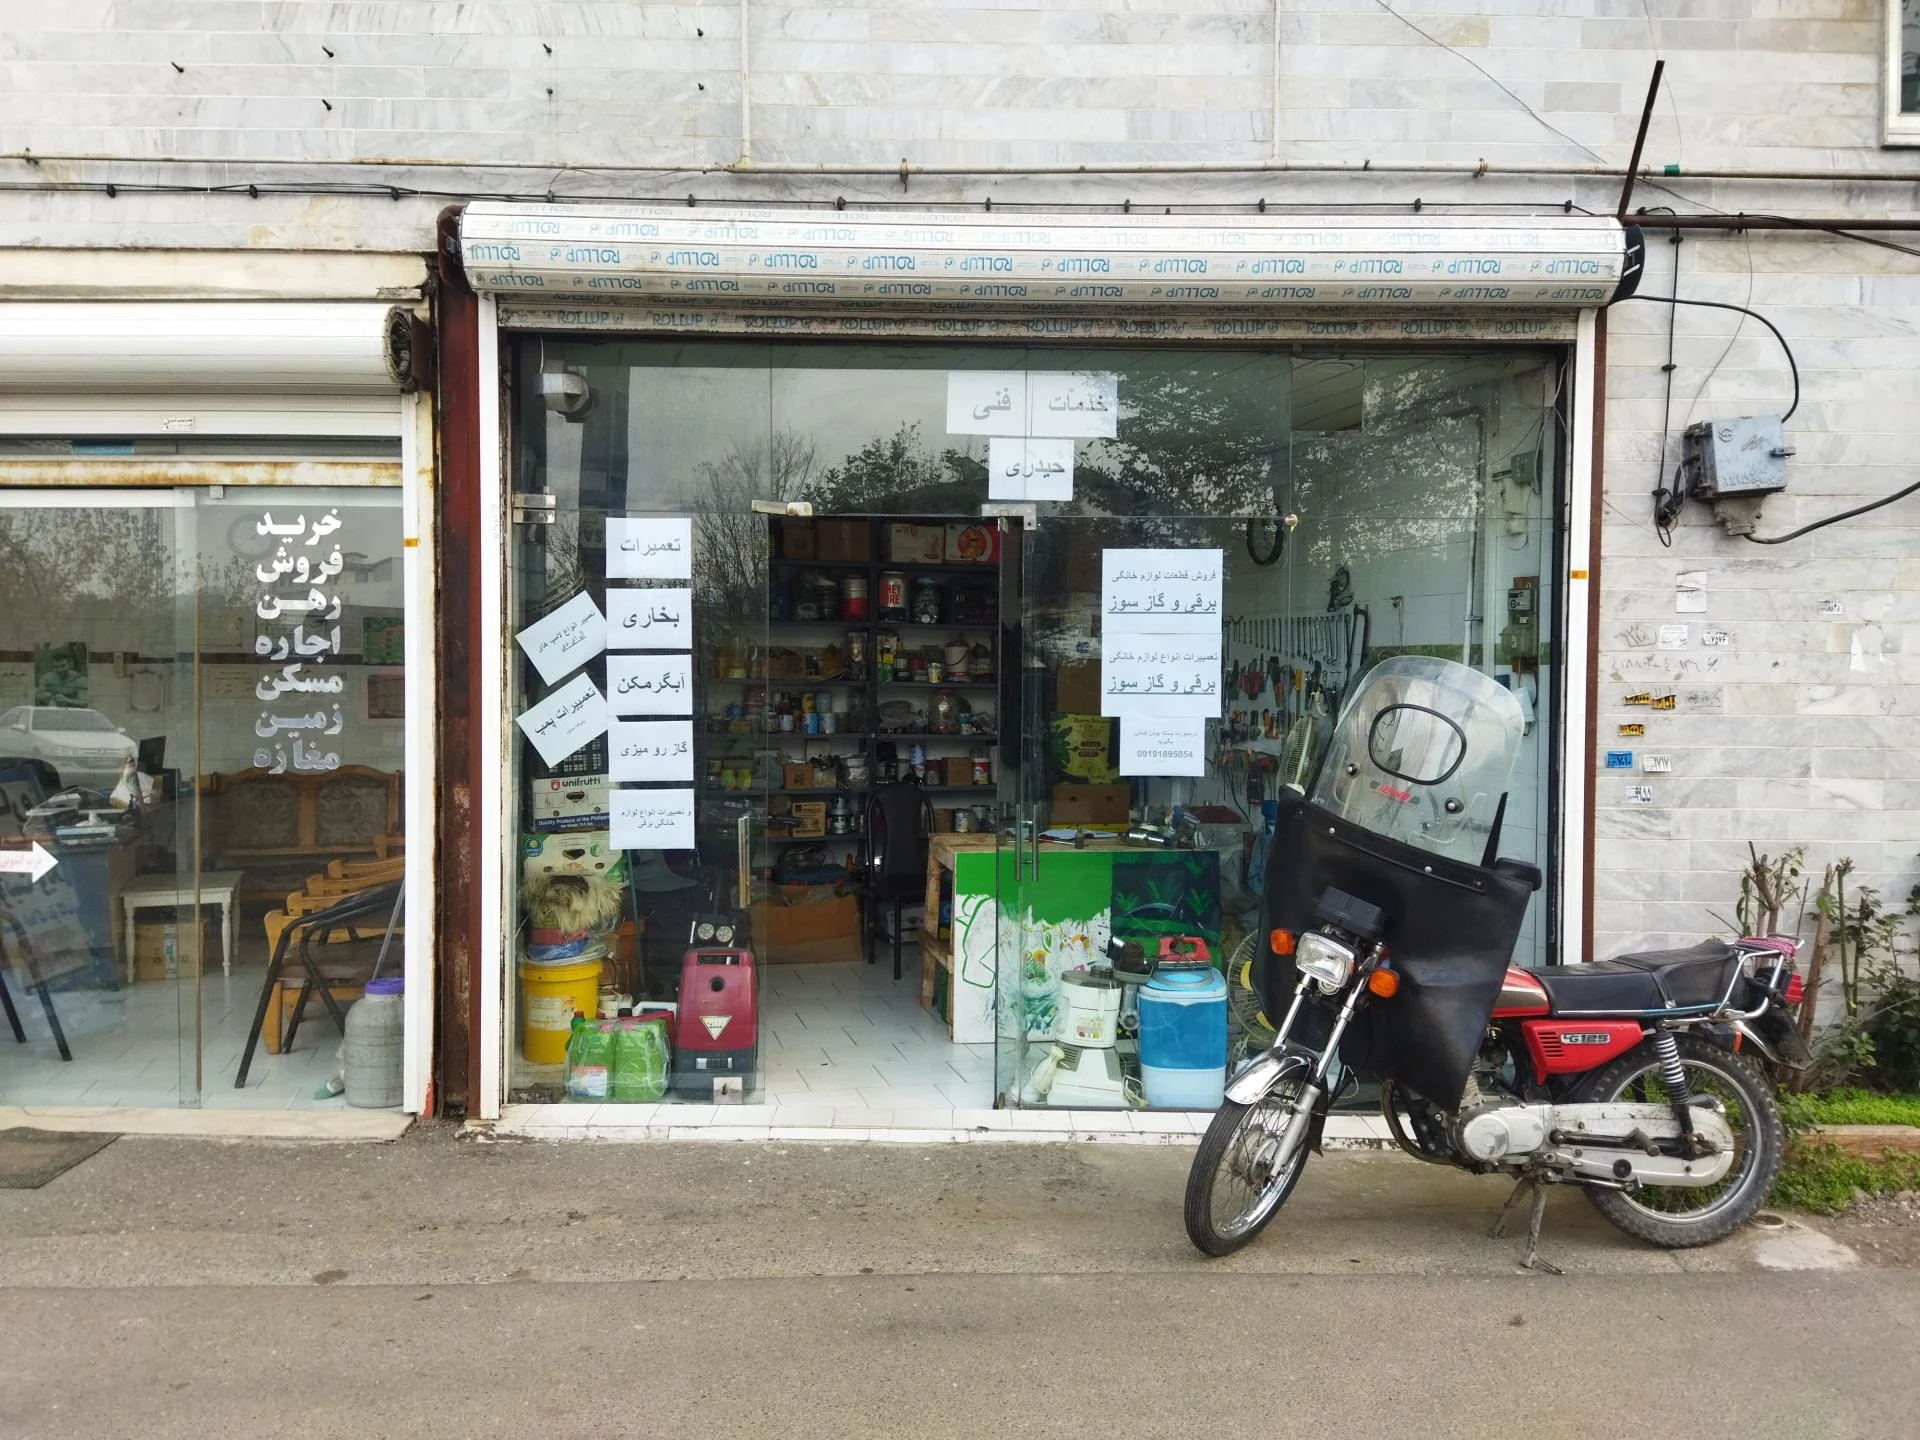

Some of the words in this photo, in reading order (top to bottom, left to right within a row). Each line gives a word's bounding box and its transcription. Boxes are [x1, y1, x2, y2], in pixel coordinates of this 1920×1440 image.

[566, 248, 620, 264] ROLLUP
[665, 250, 719, 266] ROLLUP
[764, 254, 817, 269] ROLLUP
[862, 255, 915, 270] ROLLUP
[960, 257, 1013, 272] ROLLUP
[1057, 258, 1110, 273] ROLLUP
[1154, 259, 1207, 273] ROLLUP
[1252, 259, 1305, 274] ROLLUP
[1350, 259, 1403, 274] ROLLUP
[1448, 259, 1501, 274] ROLLUP
[1545, 260, 1599, 274] ROLLUP
[490, 274, 544, 286] ROLLUP
[588, 277, 642, 289] ROLLUP
[686, 279, 739, 291] ROLLUP
[783, 282, 835, 294] ROLLUP
[879, 283, 931, 295] ROLLUP
[974, 285, 1027, 297] ROLLUP
[1070, 286, 1123, 298] ROLLUP
[1166, 287, 1219, 298] ROLLUP
[1262, 287, 1315, 298] ROLLUP
[1358, 287, 1413, 299] ROLLUP
[1454, 287, 1510, 299] ROLLUP
[1551, 288, 1606, 299] ROLLUP
[652, 312, 704, 326] ROLLUP
[1400, 320, 1450, 334] ROLLUP
[1495, 320, 1547, 334] ROLLUP
[972, 387, 1012, 420] فنی
[1049, 389, 1108, 412] خدمات
[1005, 459, 1065, 478] حیدری
[256, 508, 342, 545] خرید
[620, 537, 681, 556] تعمیرات
[256, 544, 344, 584] فروش
[1111, 569, 1138, 582] خانگی
[1140, 570, 1161, 582] لوازم
[1164, 570, 1189, 579] قطعات
[1191, 569, 1216, 582] فروش
[256, 587, 342, 620] رهن
[1108, 595, 1139, 611] سوز
[1144, 592, 1165, 611] گاز
[1171, 599, 1180, 611] و
[1184, 593, 1217, 614] برقی
[622, 606, 680, 628] بخاری
[255, 625, 341, 664] اجاره
[1109, 650, 1135, 663] خانگی
[1138, 651, 1158, 662] لوازم
[1160, 651, 1180, 664] انواع
[255, 663, 343, 700] مسکن
[617, 672, 685, 693] آبگرمکن
[1107, 676, 1138, 692] سوز
[1143, 673, 1164, 692] گاز
[1170, 679, 1179, 692] و
[1183, 674, 1216, 694] برقی
[255, 703, 343, 738] زمین
[535, 718, 557, 736] پمپ
[620, 744, 648, 756] میزی
[653, 746, 667, 756] رو
[671, 741, 688, 756] گاز
[1137, 750, 1193, 758] 09191895054
[253, 739, 341, 774] مغازه
[562, 776, 601, 787] unifrutti
